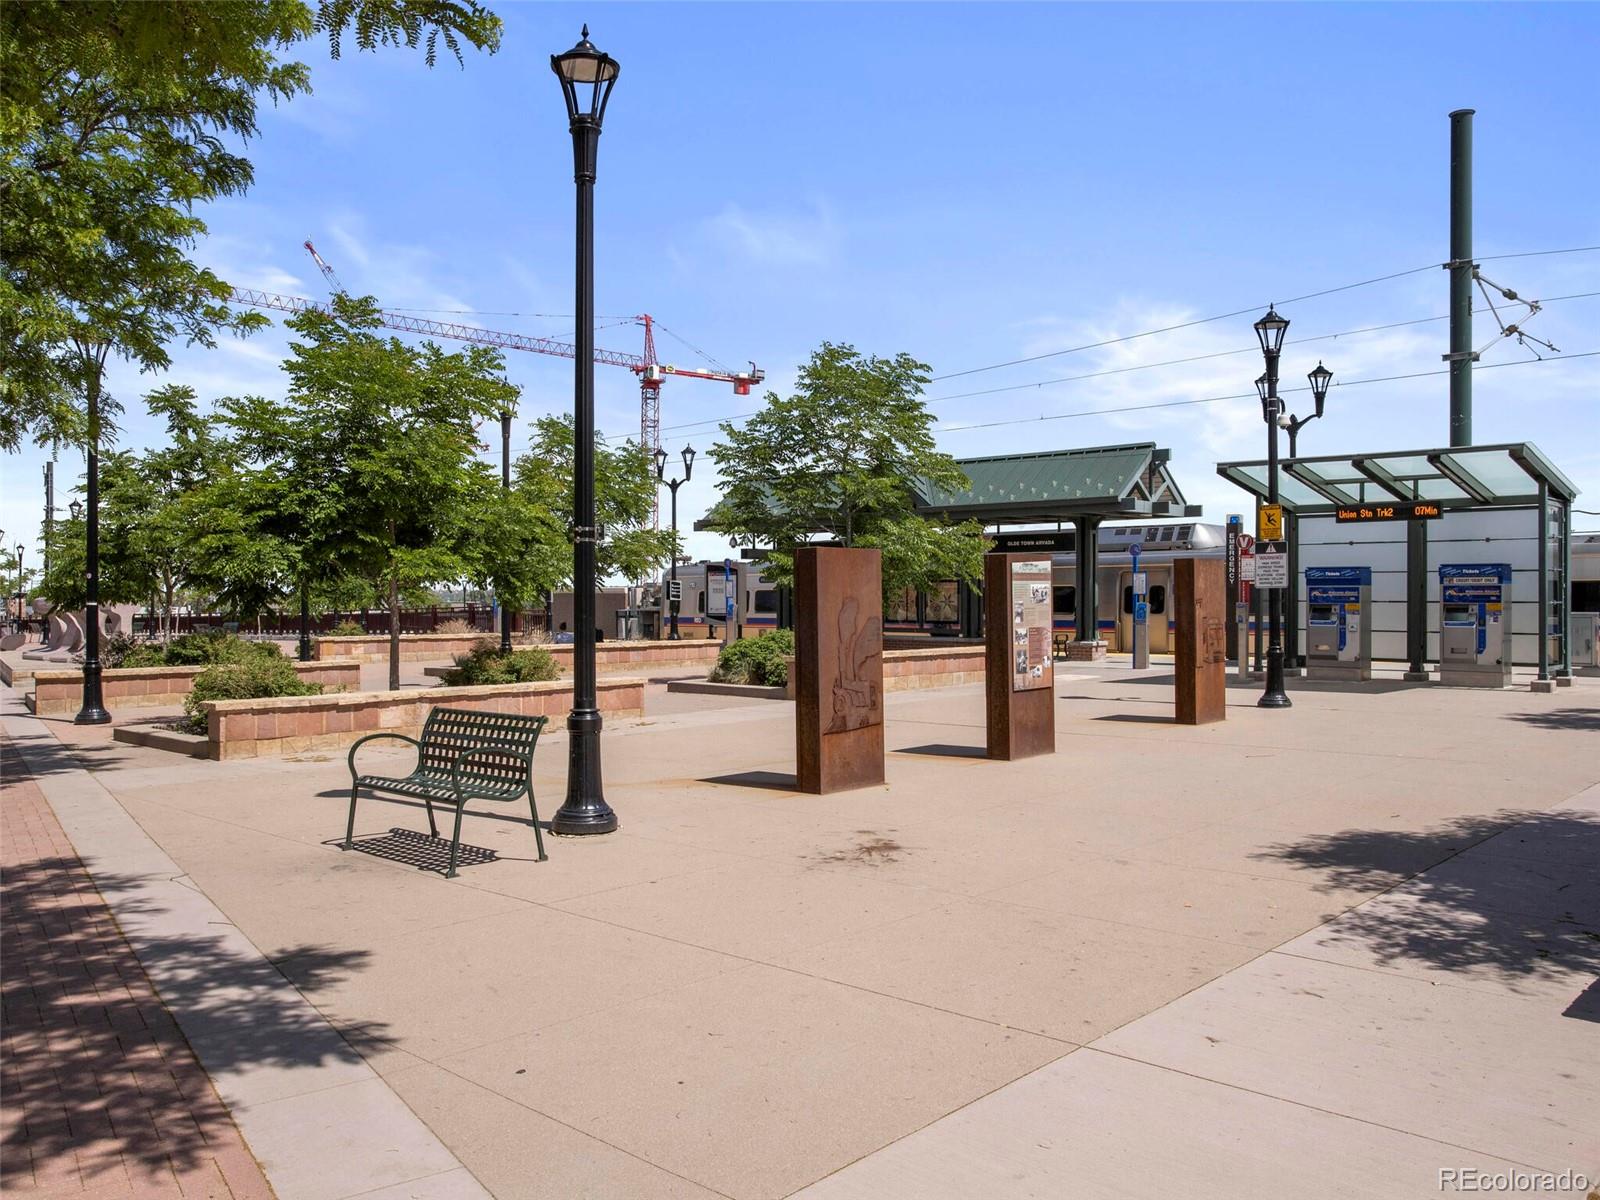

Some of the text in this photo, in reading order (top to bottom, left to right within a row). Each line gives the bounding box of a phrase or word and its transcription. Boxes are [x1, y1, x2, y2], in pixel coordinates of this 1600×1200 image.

[1339, 505, 1438, 518] Union Stn Trk2 07Min
[1239, 537, 1249, 548] V
